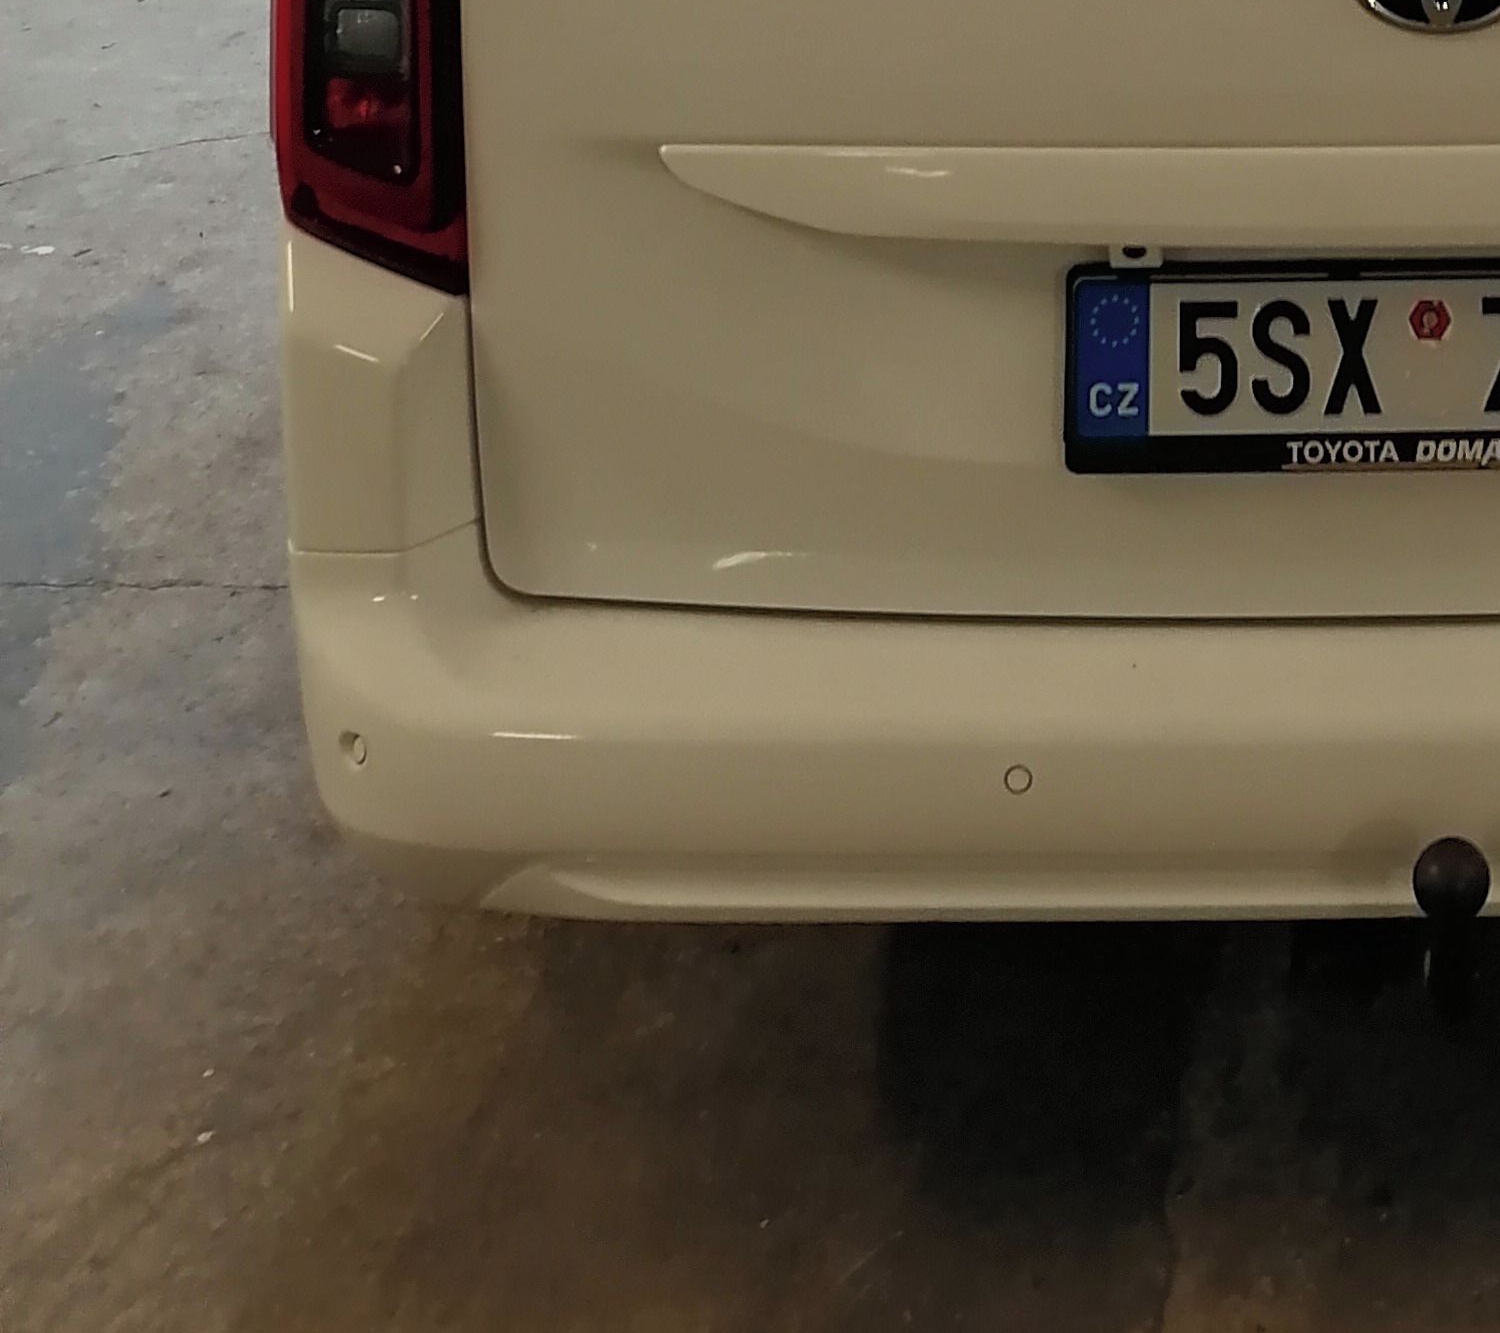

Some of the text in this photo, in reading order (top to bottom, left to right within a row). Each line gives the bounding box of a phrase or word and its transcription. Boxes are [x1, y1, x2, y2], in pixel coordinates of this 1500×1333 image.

[1179, 298, 1382, 415] 5SX
[1088, 382, 1140, 418] CZ
[1286, 439, 1400, 464] TOYOTA
